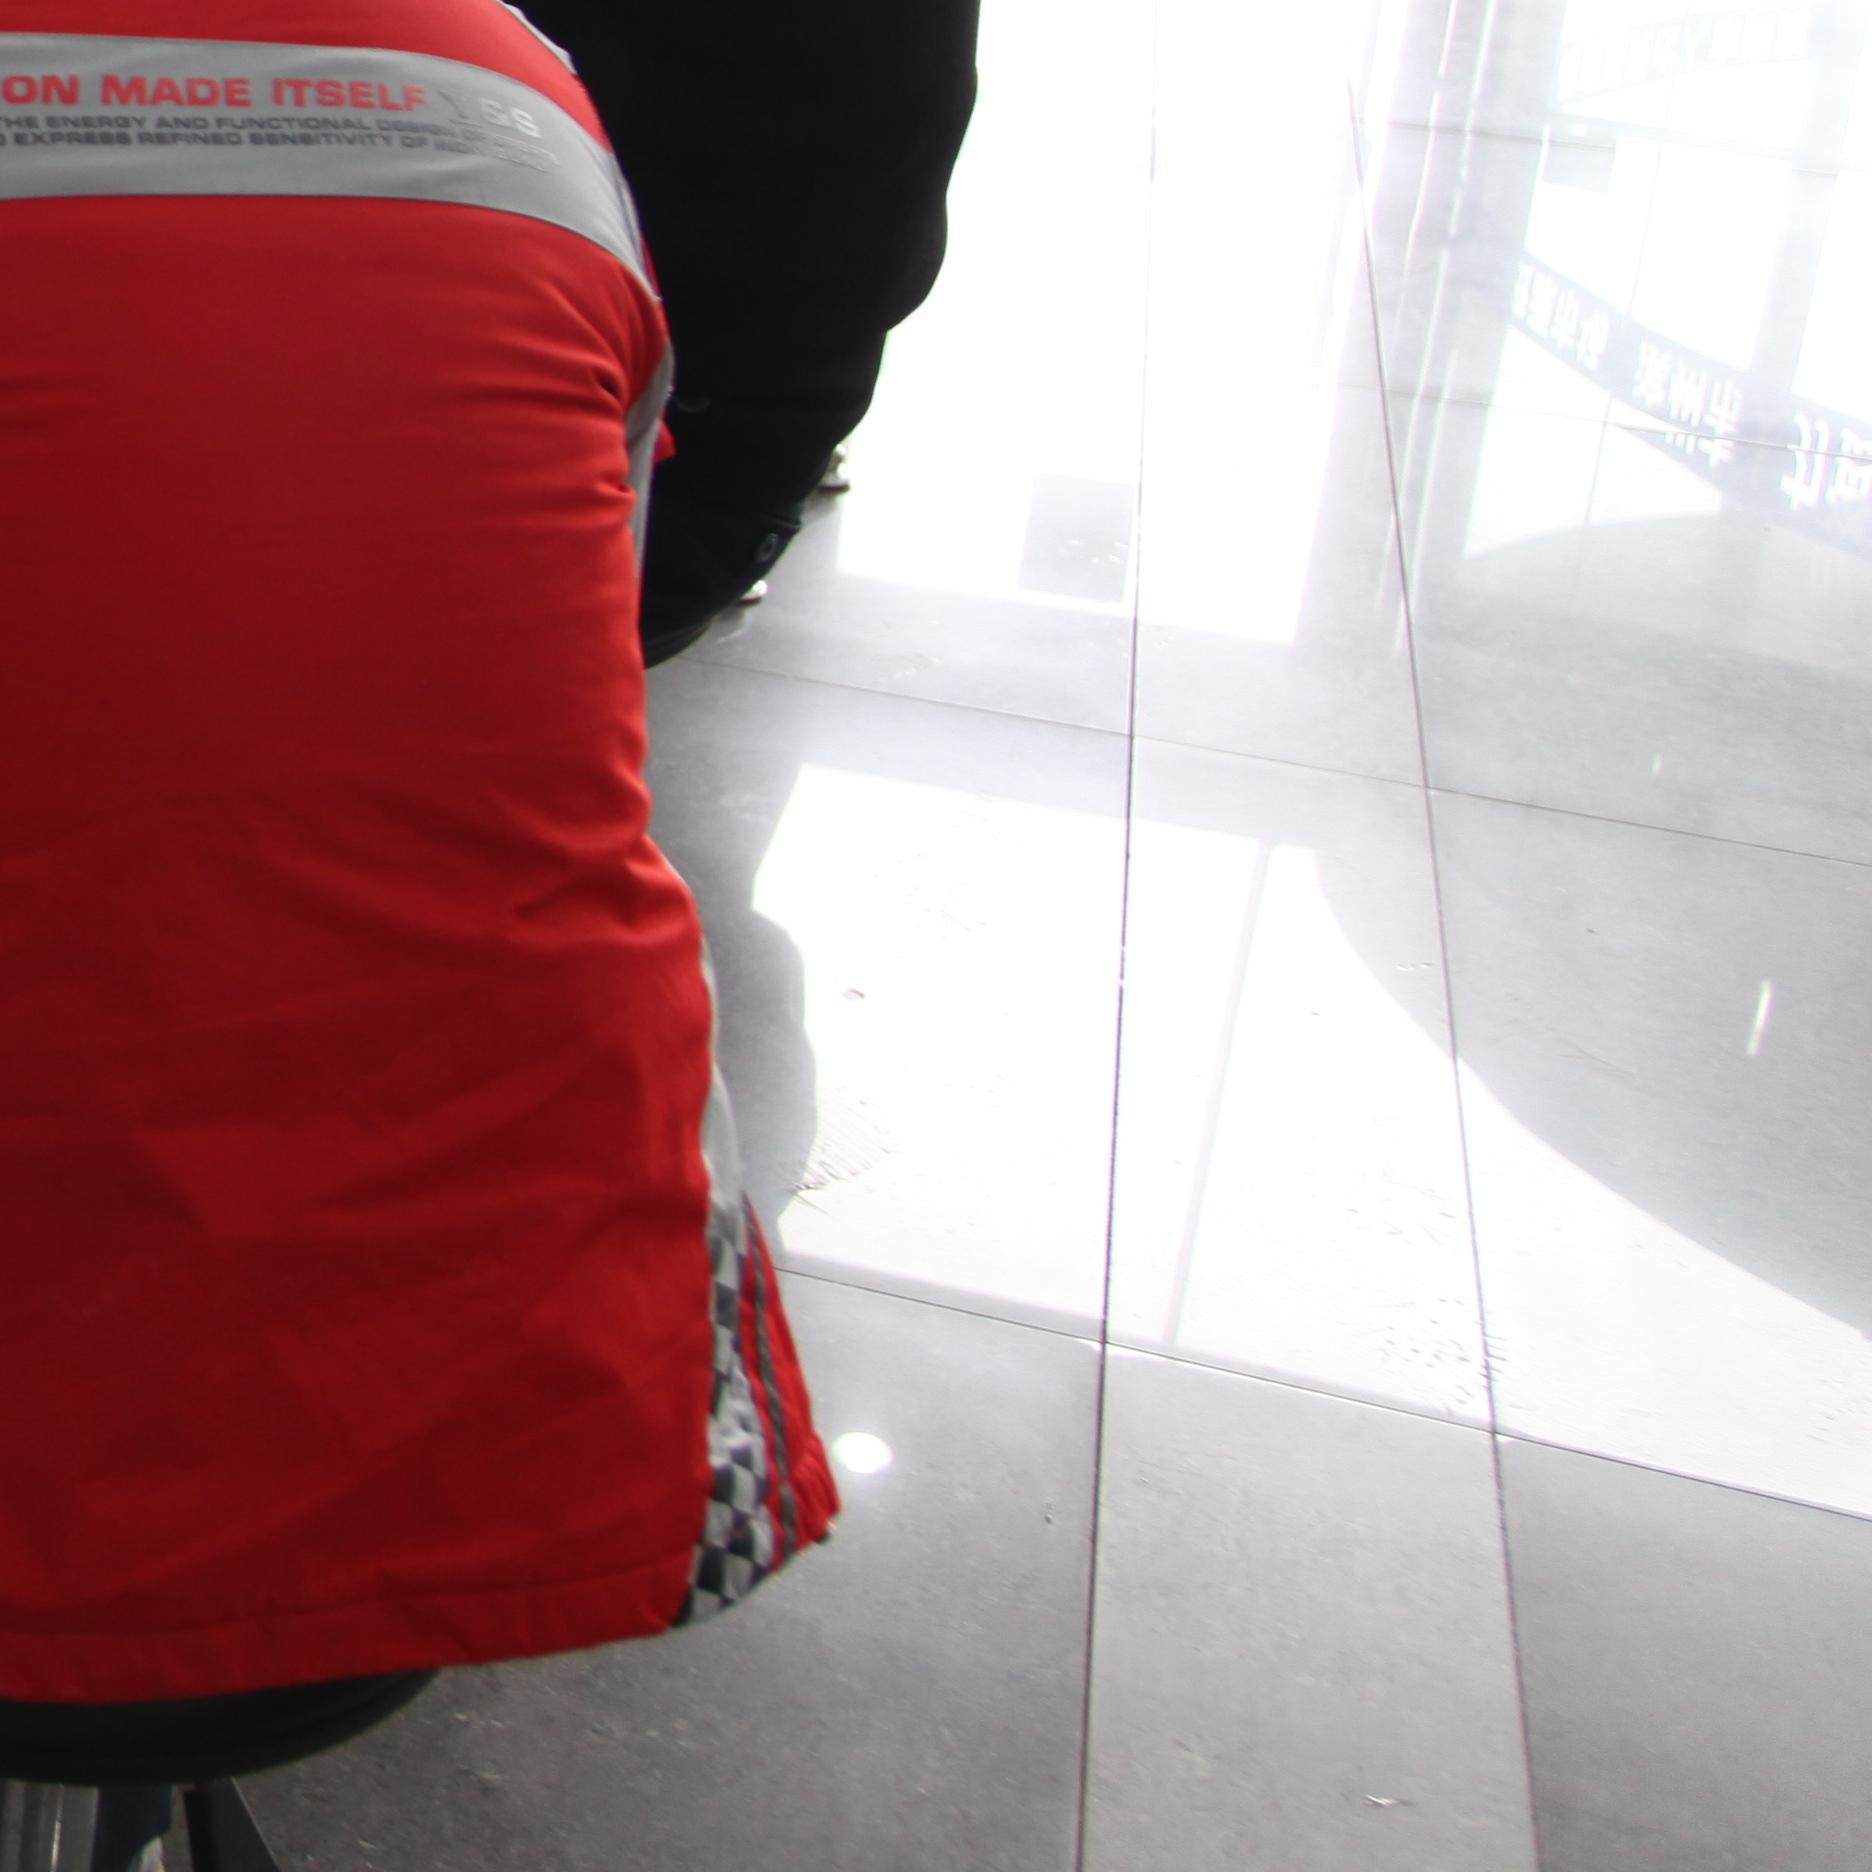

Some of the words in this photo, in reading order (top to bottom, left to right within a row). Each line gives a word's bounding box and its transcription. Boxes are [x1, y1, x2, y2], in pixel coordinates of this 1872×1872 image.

[100, 74, 252, 108] MADE
[272, 77, 429, 112] ITSELF
[45, 115, 147, 129] ENERGY
[156, 116, 210, 129] AND
[215, 116, 373, 131] FUNCTIONAL
[13, 131, 133, 147] EXPRESS
[138, 132, 244, 146] REFINED
[248, 131, 395, 147] SENSITIVITY
[401, 134, 430, 148] OF
